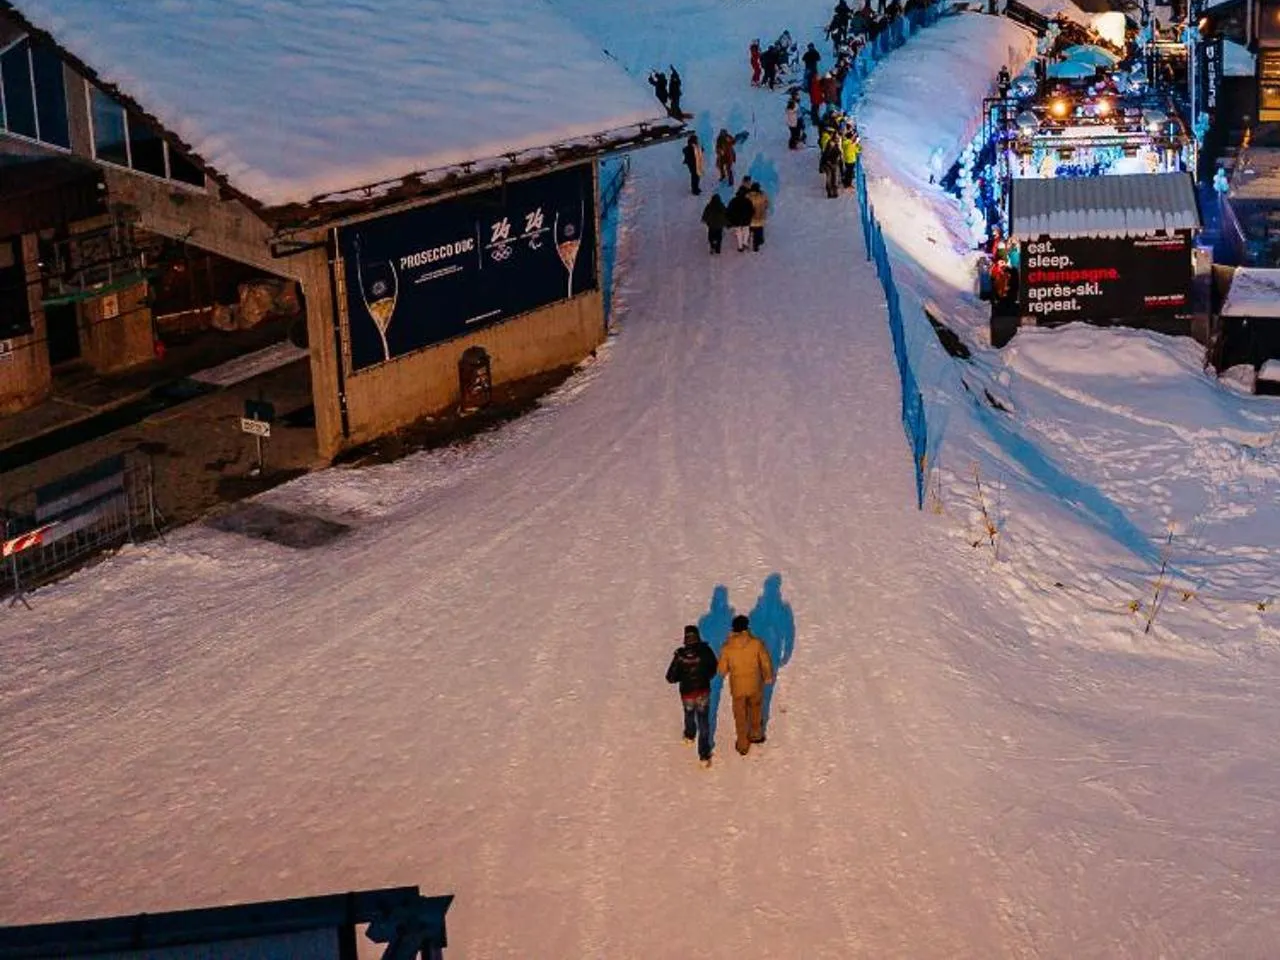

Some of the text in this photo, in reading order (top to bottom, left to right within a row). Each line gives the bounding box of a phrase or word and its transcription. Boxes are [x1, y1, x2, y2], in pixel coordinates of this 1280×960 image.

[400, 238, 475, 270] PROSECCO DOC
[1027, 241, 1056, 254] eat.
[1028, 254, 1074, 270] sleep.
[1028, 282, 1103, 300] après-ski.
[1028, 298, 1081, 315] repeat.
